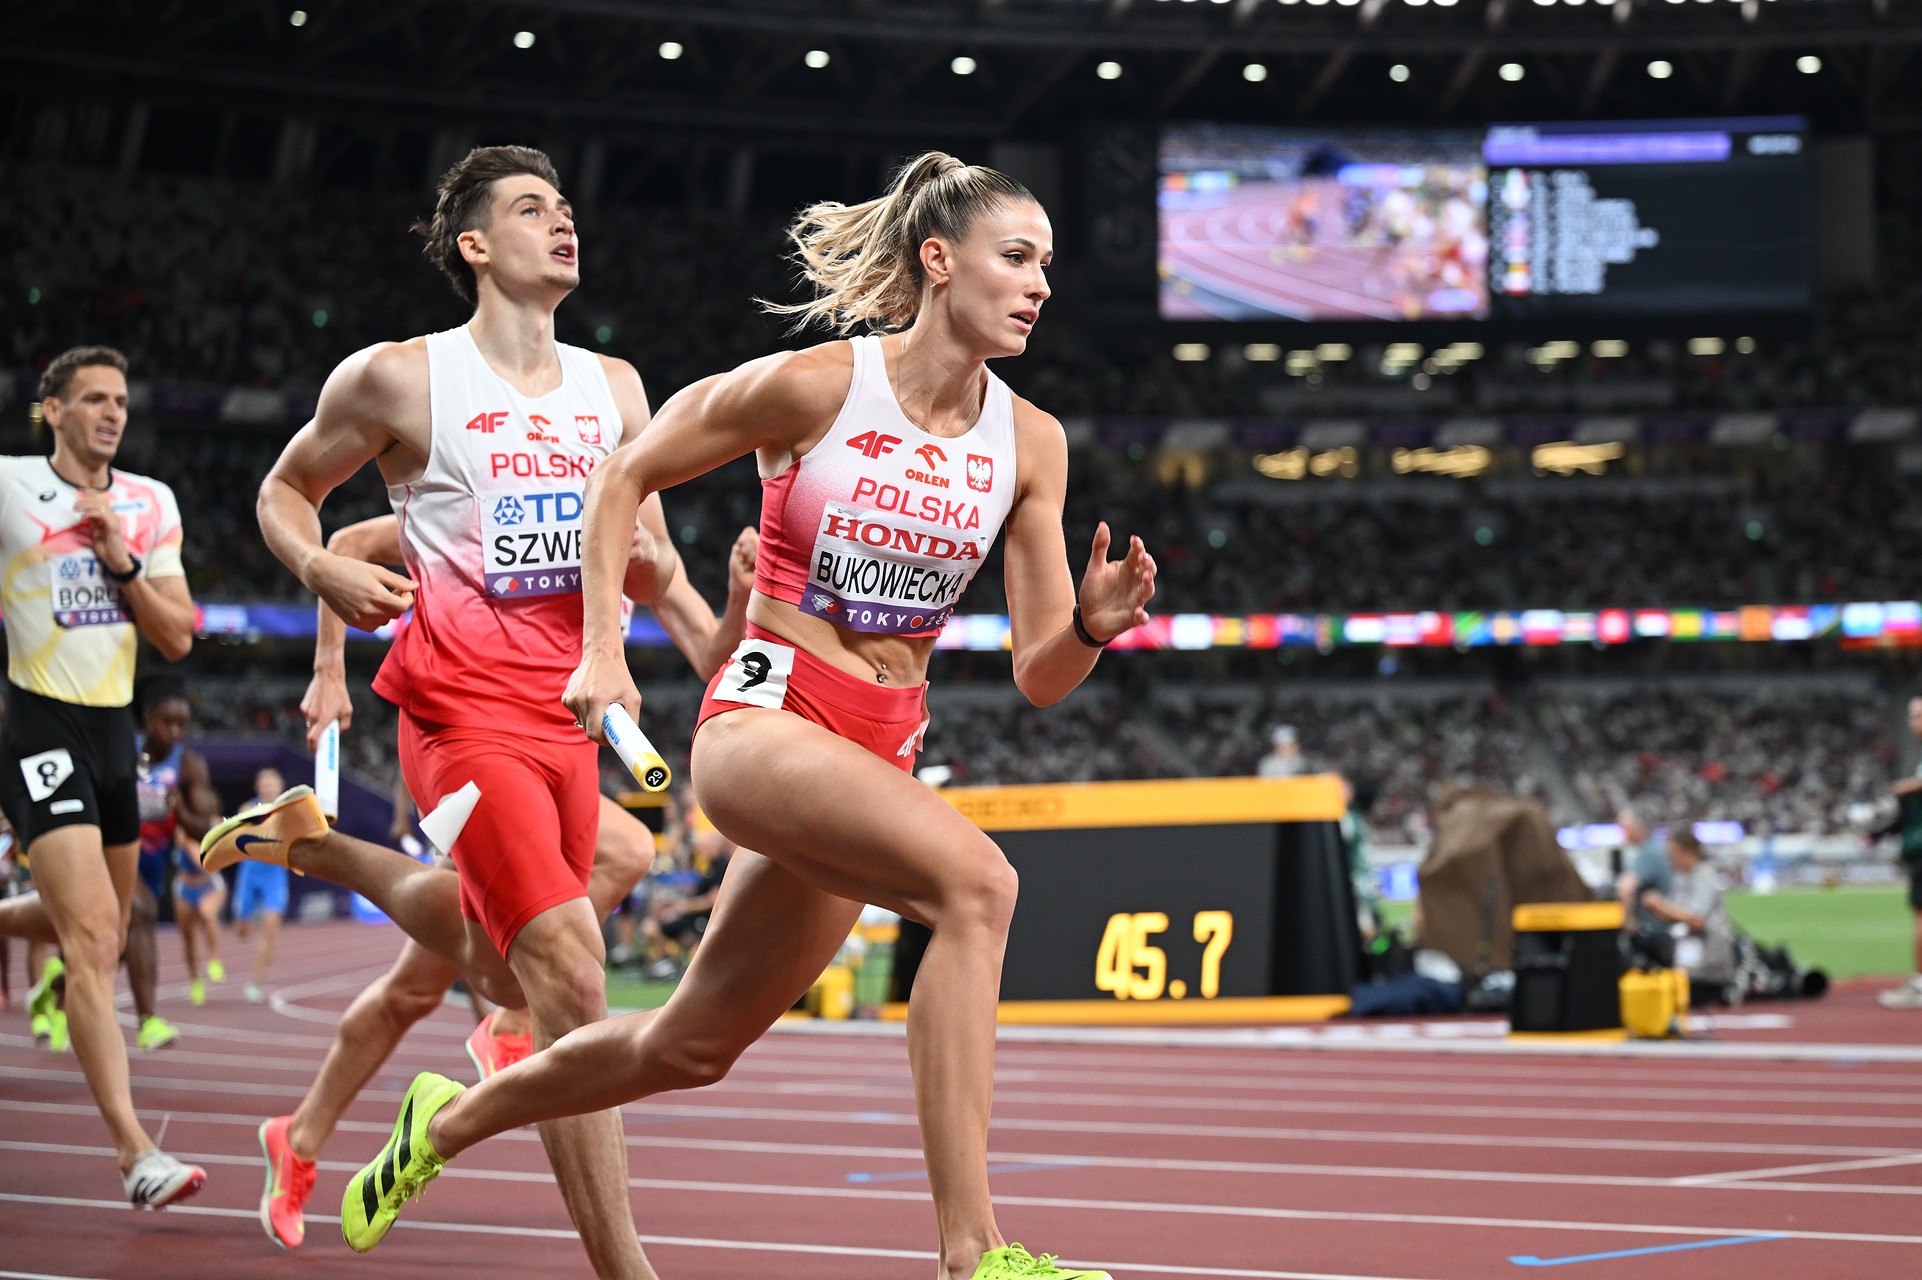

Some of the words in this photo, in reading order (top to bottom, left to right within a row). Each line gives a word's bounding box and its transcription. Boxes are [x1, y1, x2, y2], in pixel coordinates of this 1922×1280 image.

[466, 411, 509, 433] 4F
[846, 430, 903, 459] 4F
[905, 468, 950, 489] ORLEN
[524, 491, 583, 523] TD
[851, 476, 980, 530] POLSKA
[822, 514, 981, 561] HONDA
[816, 550, 965, 604] BUKOWIECKA
[736, 651, 772, 693] 9
[37, 761, 58, 789] 8
[647, 770, 664, 786] 29
[1095, 910, 1233, 1000] 45.7
